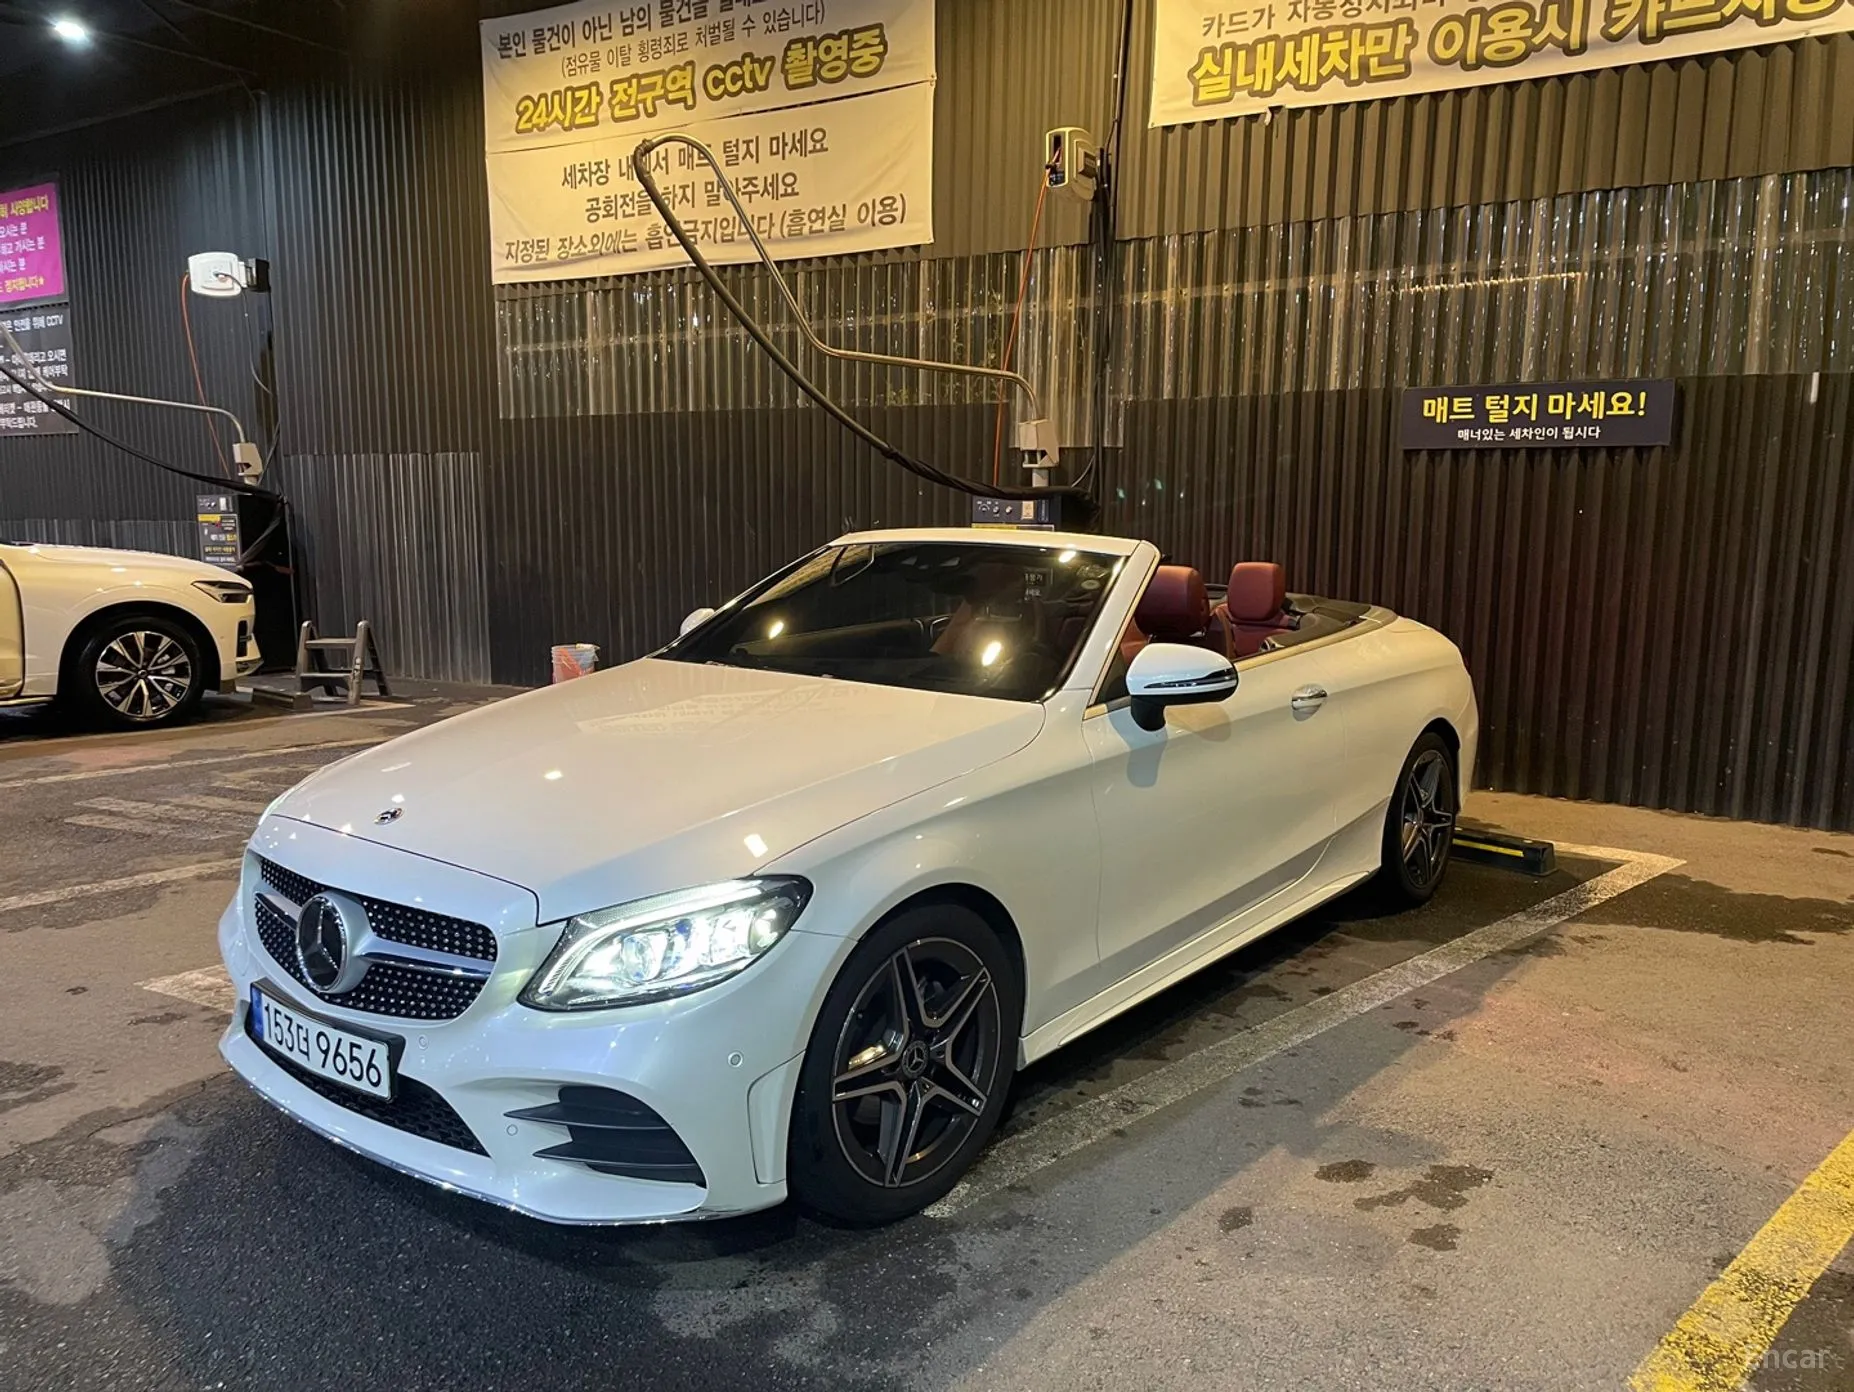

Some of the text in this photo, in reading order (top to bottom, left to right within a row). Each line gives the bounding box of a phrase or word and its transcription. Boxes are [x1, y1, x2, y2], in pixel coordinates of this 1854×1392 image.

[498, 31, 526, 59] 본인
[532, 21, 575, 53] 물건이
[582, 13, 612, 43] 아닌
[620, 4, 652, 37] 남의
[562, 51, 601, 78] (점유물
[607, 46, 631, 68] 이탈
[637, 32, 689, 63] 횡령죄로
[695, 18, 735, 47] 처벌될
[741, 14, 756, 38] 수
[763, 4, 825, 35] 있습니다)
[1190, 19, 1415, 104] 실내세차만
[1430, 0, 1587, 70] 이용시
[1202, 11, 1274, 38] 카드가
[516, 24, 887, 133] 24시간 전구역 cctv 촬영중
[562, 158, 610, 189] 세차장
[723, 135, 760, 167] 털지
[769, 127, 828, 160] 마세요
[585, 171, 800, 223] 공회전을 하지 말아주세요
[505, 238, 550, 264] 지정된
[557, 229, 638, 260] 장소외에는
[779, 203, 847, 238] (흡연실
[857, 193, 906, 227] 이용)
[1423, 391, 1647, 424] 매트 털지 마세요!
[1457, 425, 1601, 442] 매너있는 세차인이 됩시다
[264, 1003, 382, 1088] 153더 9656
